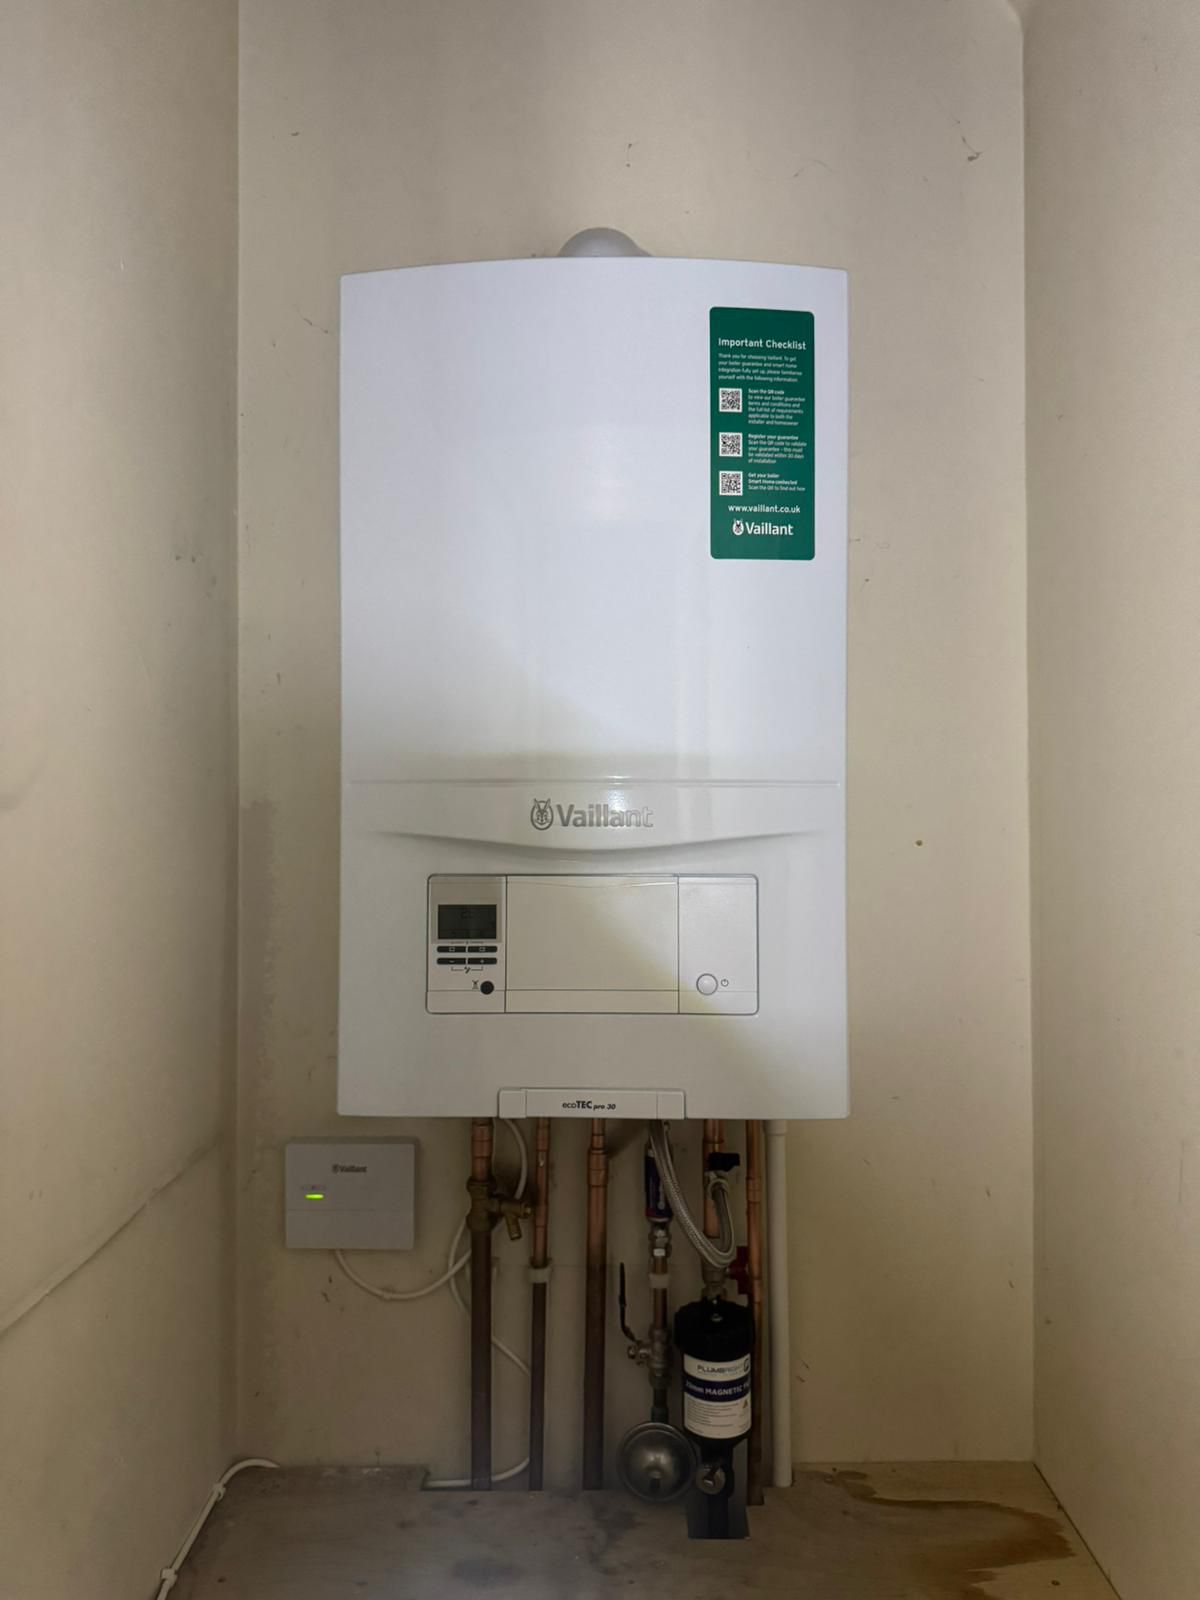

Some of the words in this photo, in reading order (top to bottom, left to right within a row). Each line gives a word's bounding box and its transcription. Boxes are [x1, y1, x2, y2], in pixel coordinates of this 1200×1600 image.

[718, 338, 763, 349] Important
[766, 339, 806, 350] Checklist
[728, 504, 800, 513] www.vaillant.co.uk
[745, 522, 794, 535] Vaillant
[556, 804, 653, 827] Vaillant
[562, 1101, 592, 1109] ecoTEC
[340, 1165, 367, 1173] Vaillant
